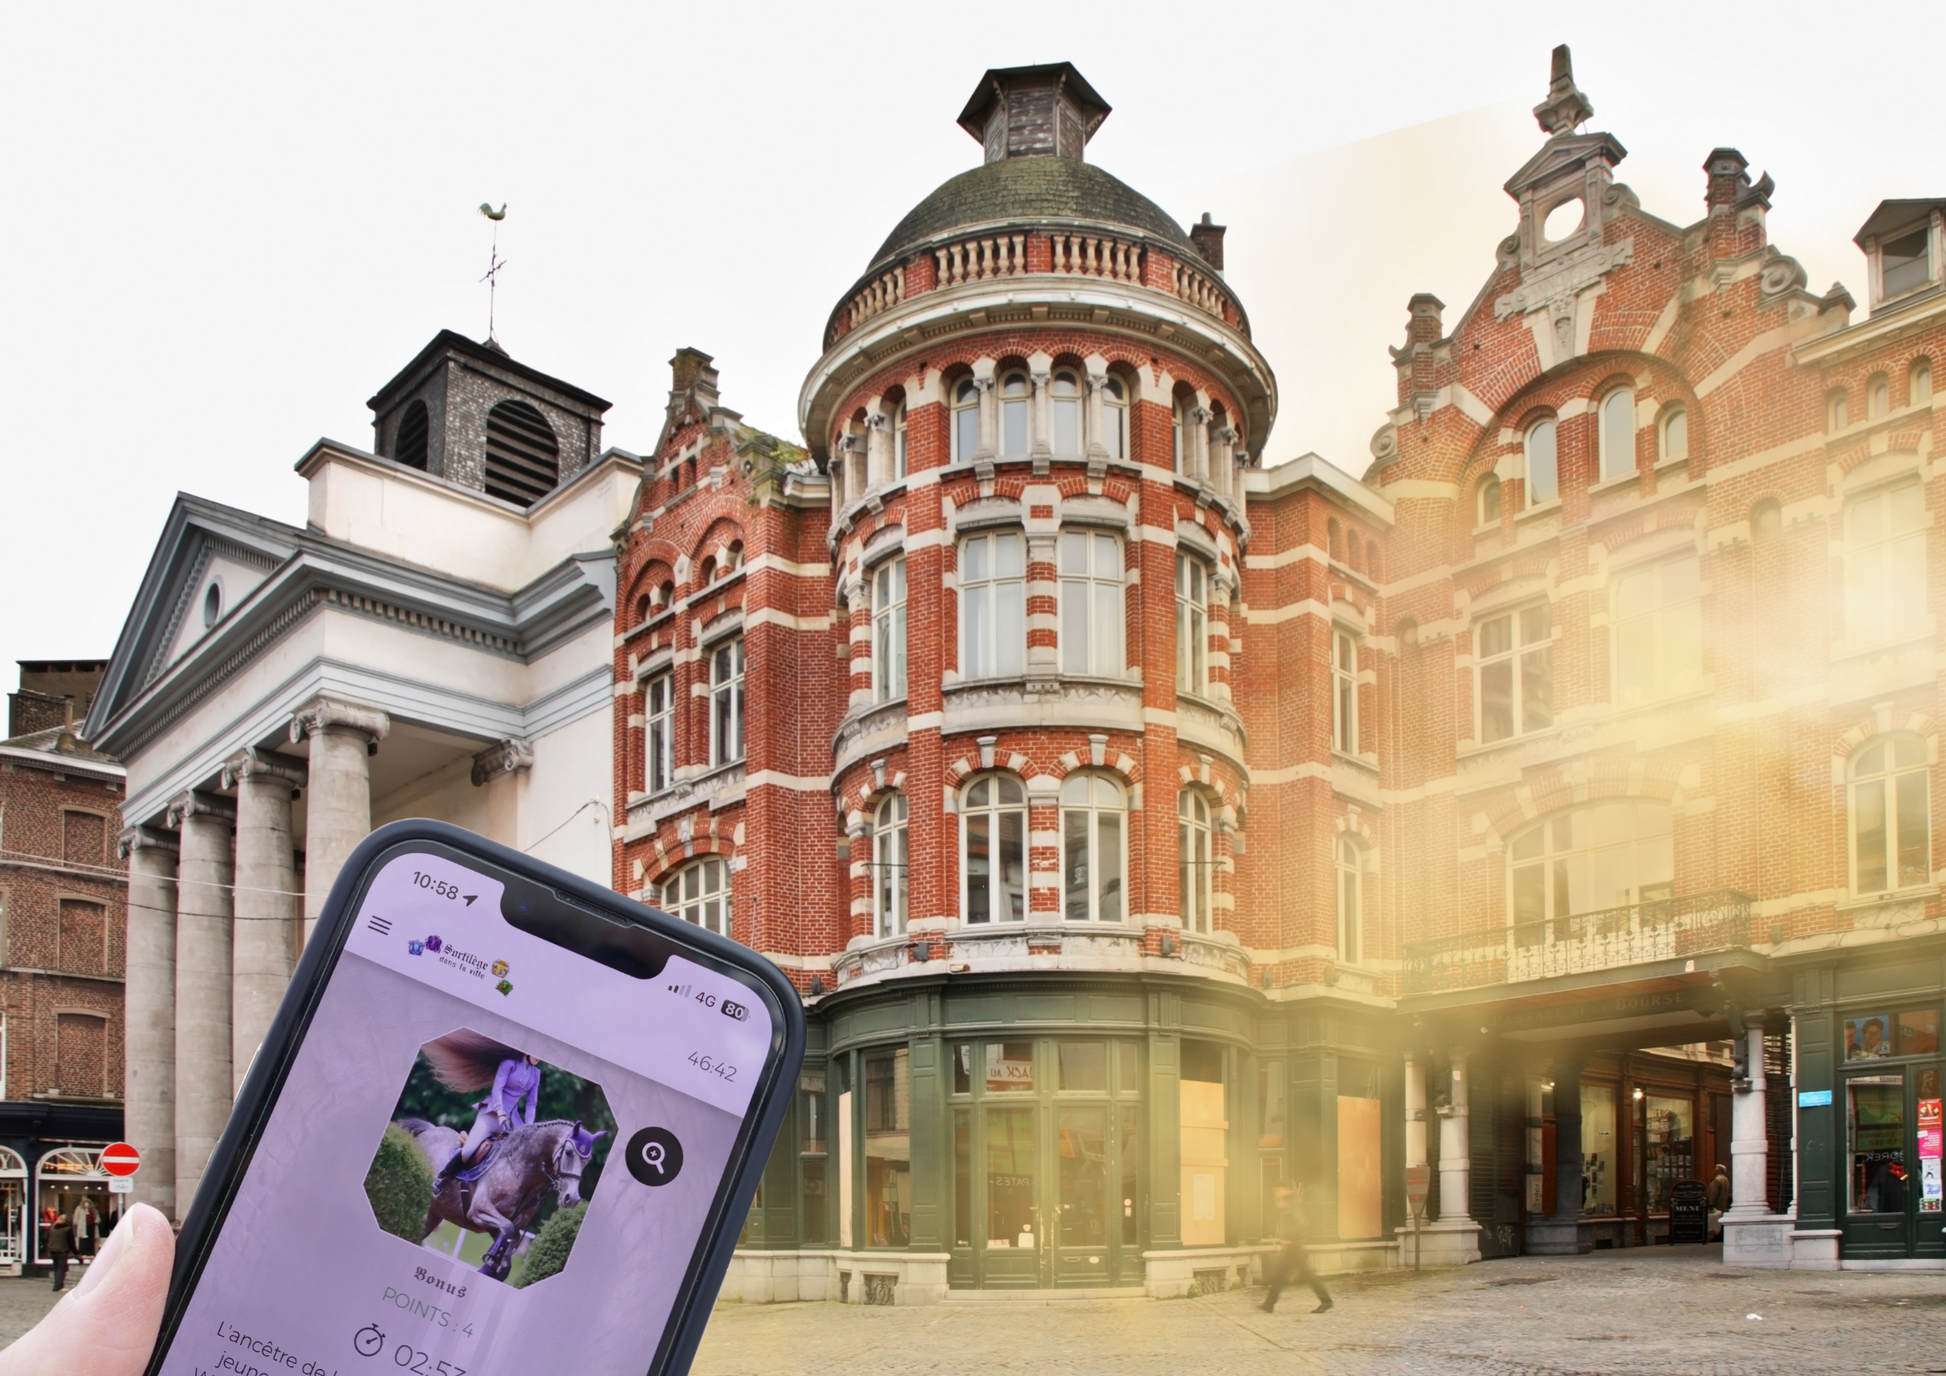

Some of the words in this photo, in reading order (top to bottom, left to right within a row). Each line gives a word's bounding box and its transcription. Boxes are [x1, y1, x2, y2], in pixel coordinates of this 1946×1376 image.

[412, 870, 459, 901] 10:58
[439, 956, 456, 968] dans
[459, 963, 467, 973] la
[469, 968, 485, 980] ville
[443, 944, 488, 971] Sortilège
[695, 991, 717, 1008] 4G
[724, 1003, 745, 1020] 80
[1492, 1008, 1564, 1027] PASSAGE
[1616, 992, 1685, 1011] BOURSE
[687, 1051, 738, 1083] 46:42
[413, 1266, 467, 1298] Bonus
[382, 1286, 451, 1327] POINTS
[462, 1323, 474, 1338] 4
[216, 1321, 298, 1368] L'ancêtre
